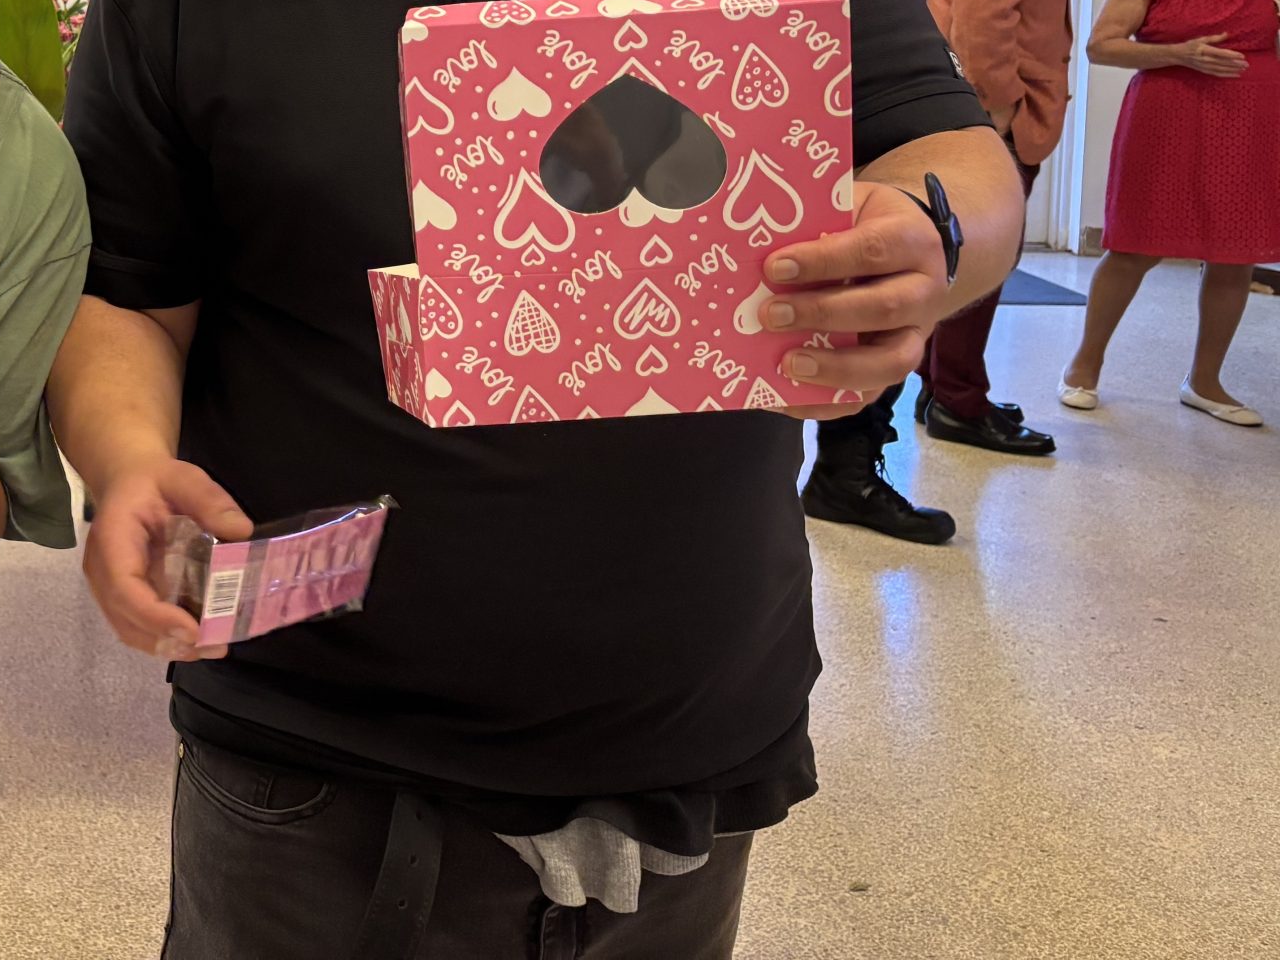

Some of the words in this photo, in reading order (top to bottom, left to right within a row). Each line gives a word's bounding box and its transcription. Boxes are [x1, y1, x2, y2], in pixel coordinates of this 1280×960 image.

[433, 39, 498, 94] love
[536, 29, 599, 90] love
[663, 29, 726, 91] love
[779, 9, 842, 71] love
[439, 135, 505, 190] love
[780, 119, 841, 180] love
[443, 243, 505, 304] love
[558, 249, 623, 304] love
[673, 242, 738, 298] love
[455, 345, 516, 406] love
[558, 342, 622, 397] love
[687, 340, 749, 398] love
